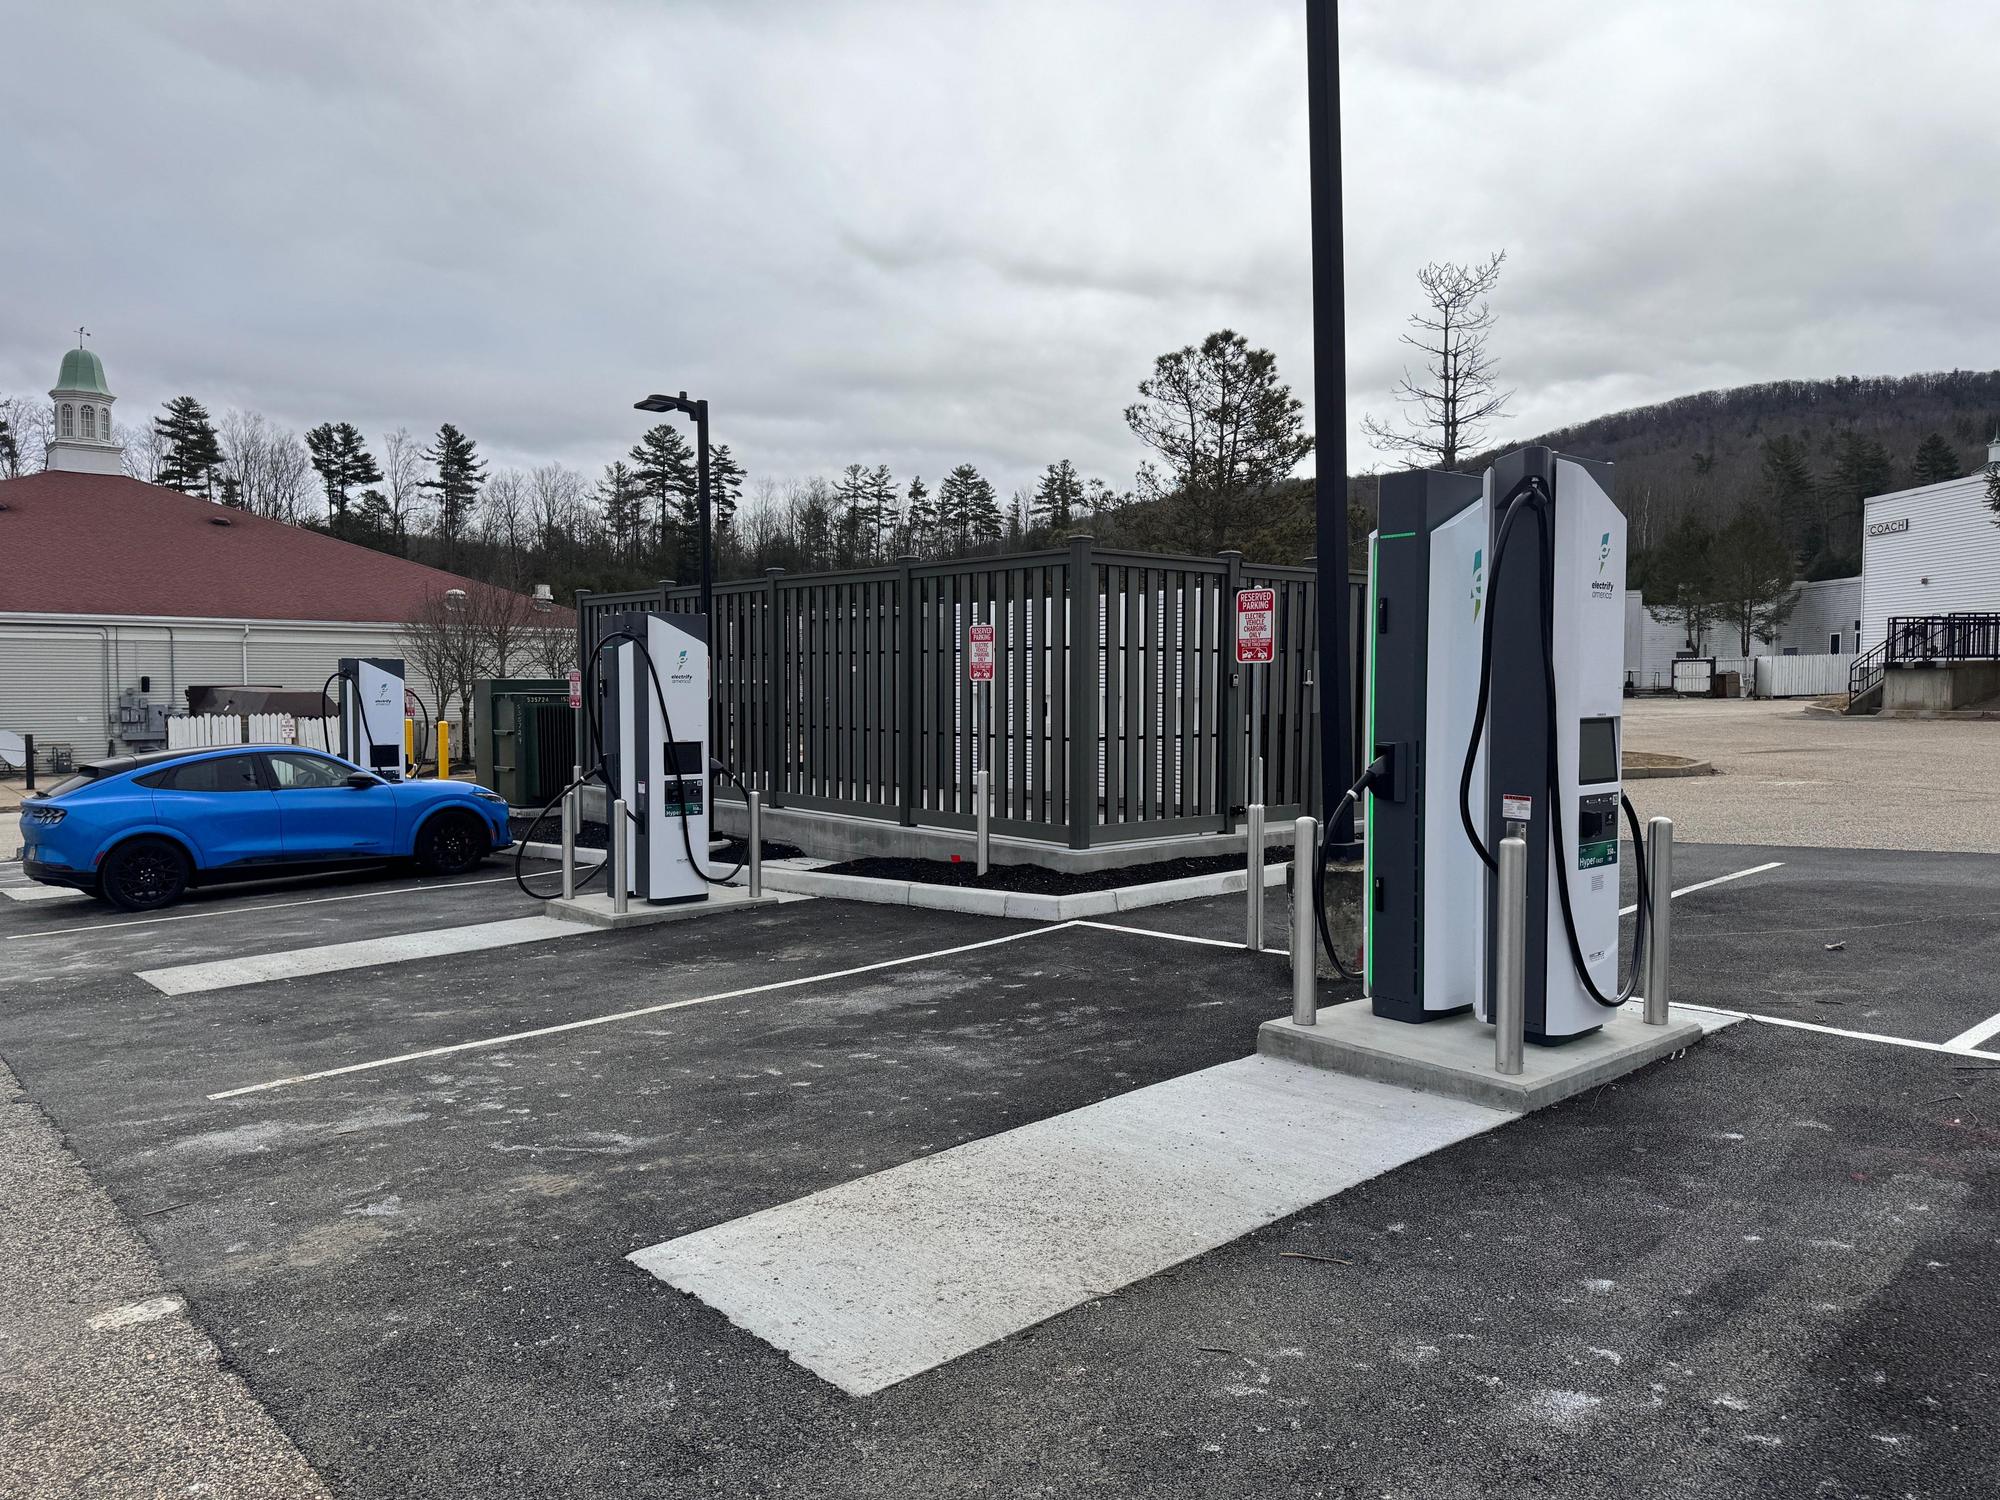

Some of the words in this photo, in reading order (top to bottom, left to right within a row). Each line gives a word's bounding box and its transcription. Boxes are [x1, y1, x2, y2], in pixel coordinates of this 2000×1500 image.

[1870, 520, 1905, 535] COACH
[1591, 580, 1614, 592] electrify
[1240, 592, 1272, 602] RESERVED
[1591, 591, 1613, 600] america
[1242, 600, 1269, 610] PARKING
[1244, 612, 1266, 620] ELECTRIC
[1243, 625, 1268, 633] CHARGING
[1579, 856, 1596, 869] Hyper
